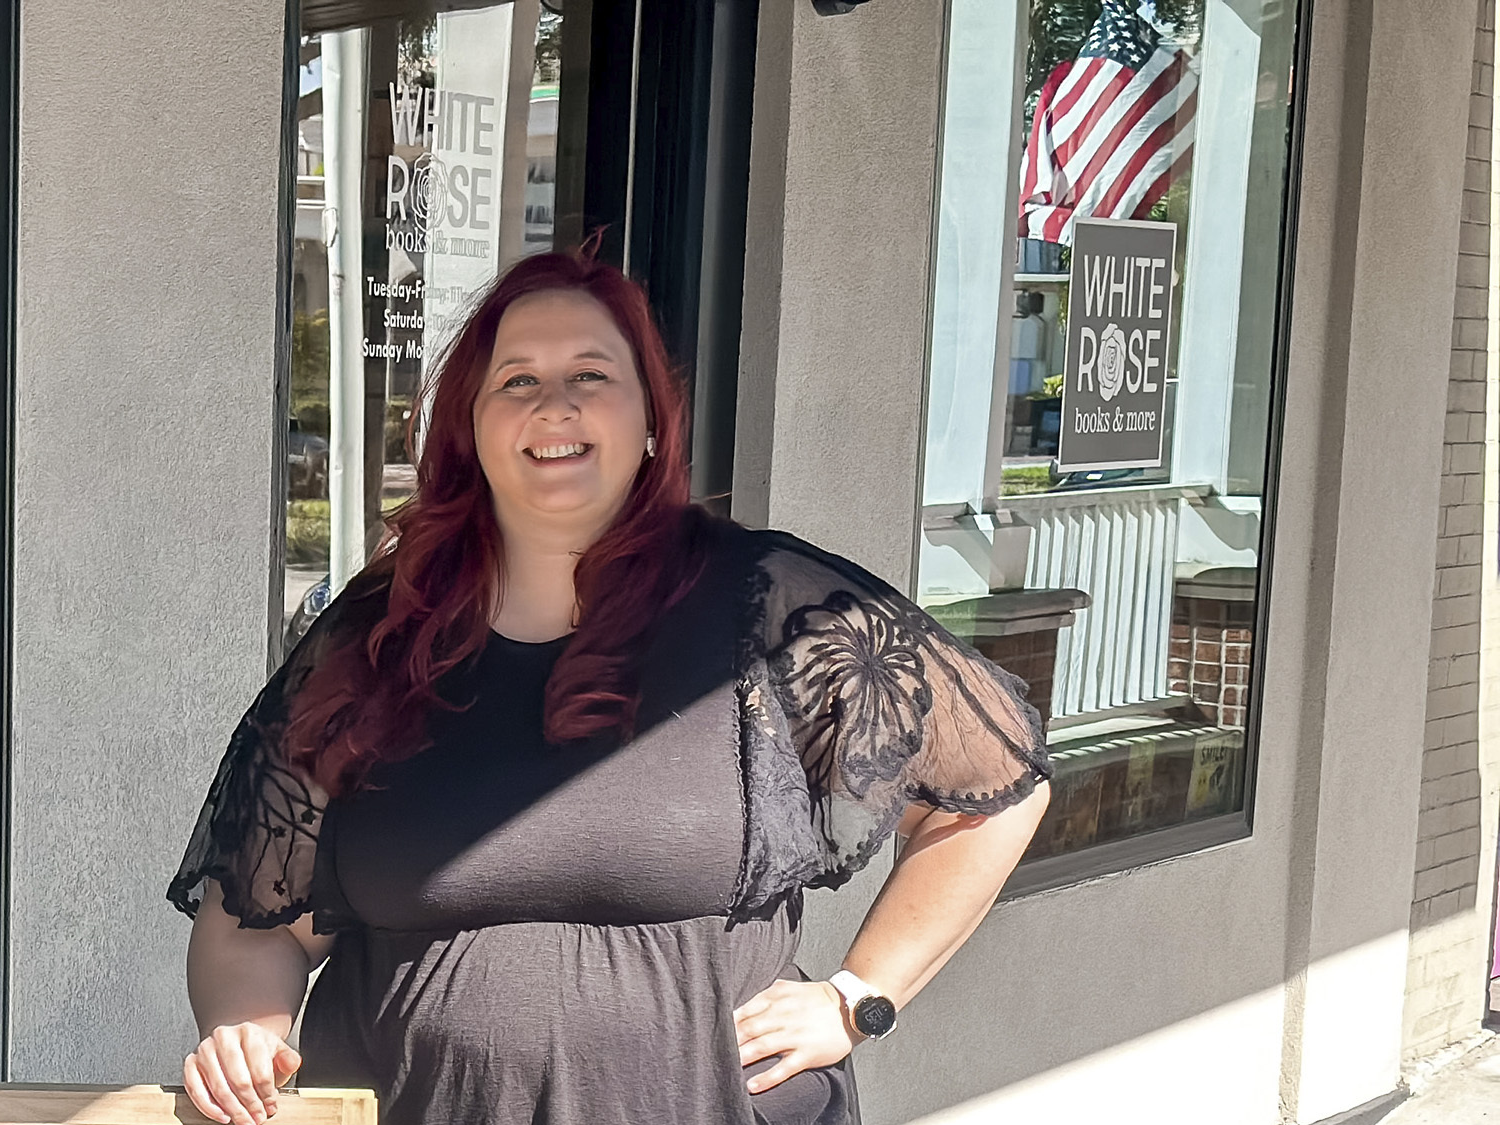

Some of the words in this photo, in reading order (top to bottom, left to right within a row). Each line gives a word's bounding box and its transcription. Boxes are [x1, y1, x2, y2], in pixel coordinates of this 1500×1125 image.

[389, 82, 494, 155] WHITE
[385, 224, 430, 253] books
[1084, 254, 1165, 318] WHITE
[363, 338, 402, 363] Sunday
[1074, 407, 1110, 434] books
[1112, 406, 1124, 433] &
[1126, 410, 1155, 432] more
